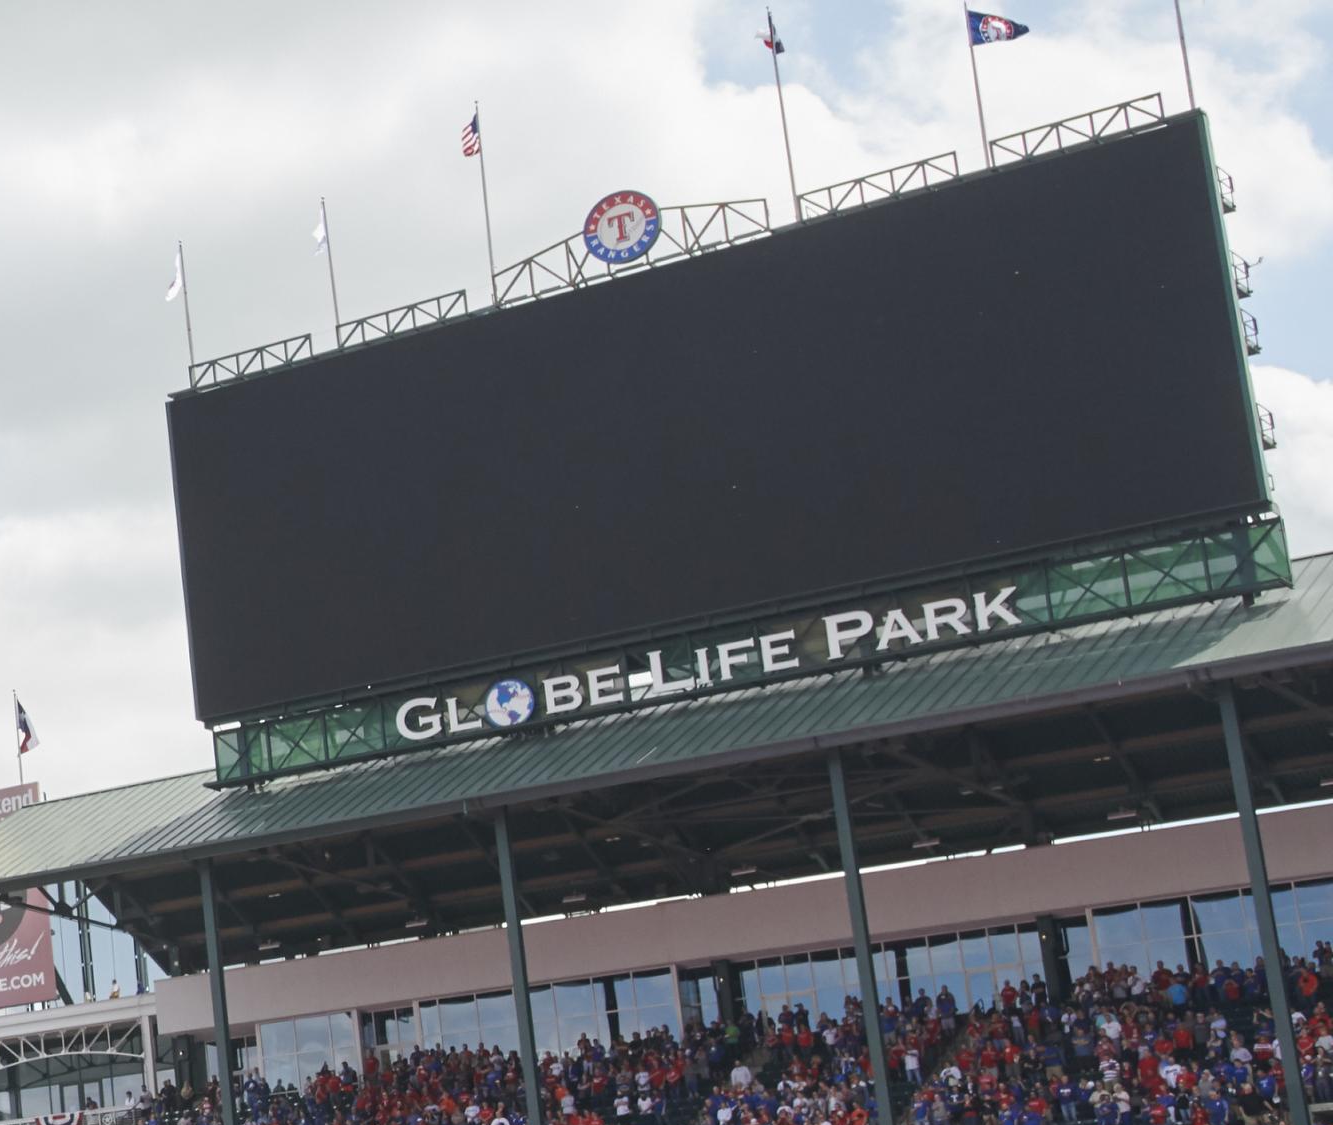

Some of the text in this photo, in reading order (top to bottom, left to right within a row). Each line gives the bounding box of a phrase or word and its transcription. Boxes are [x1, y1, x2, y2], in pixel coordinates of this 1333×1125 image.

[593, 194, 646, 219] TEXAS
[589, 223, 655, 259] RANGERS
[606, 210, 635, 242] T
[646, 629, 800, 695] LIFE
[822, 585, 1021, 660] PARK
